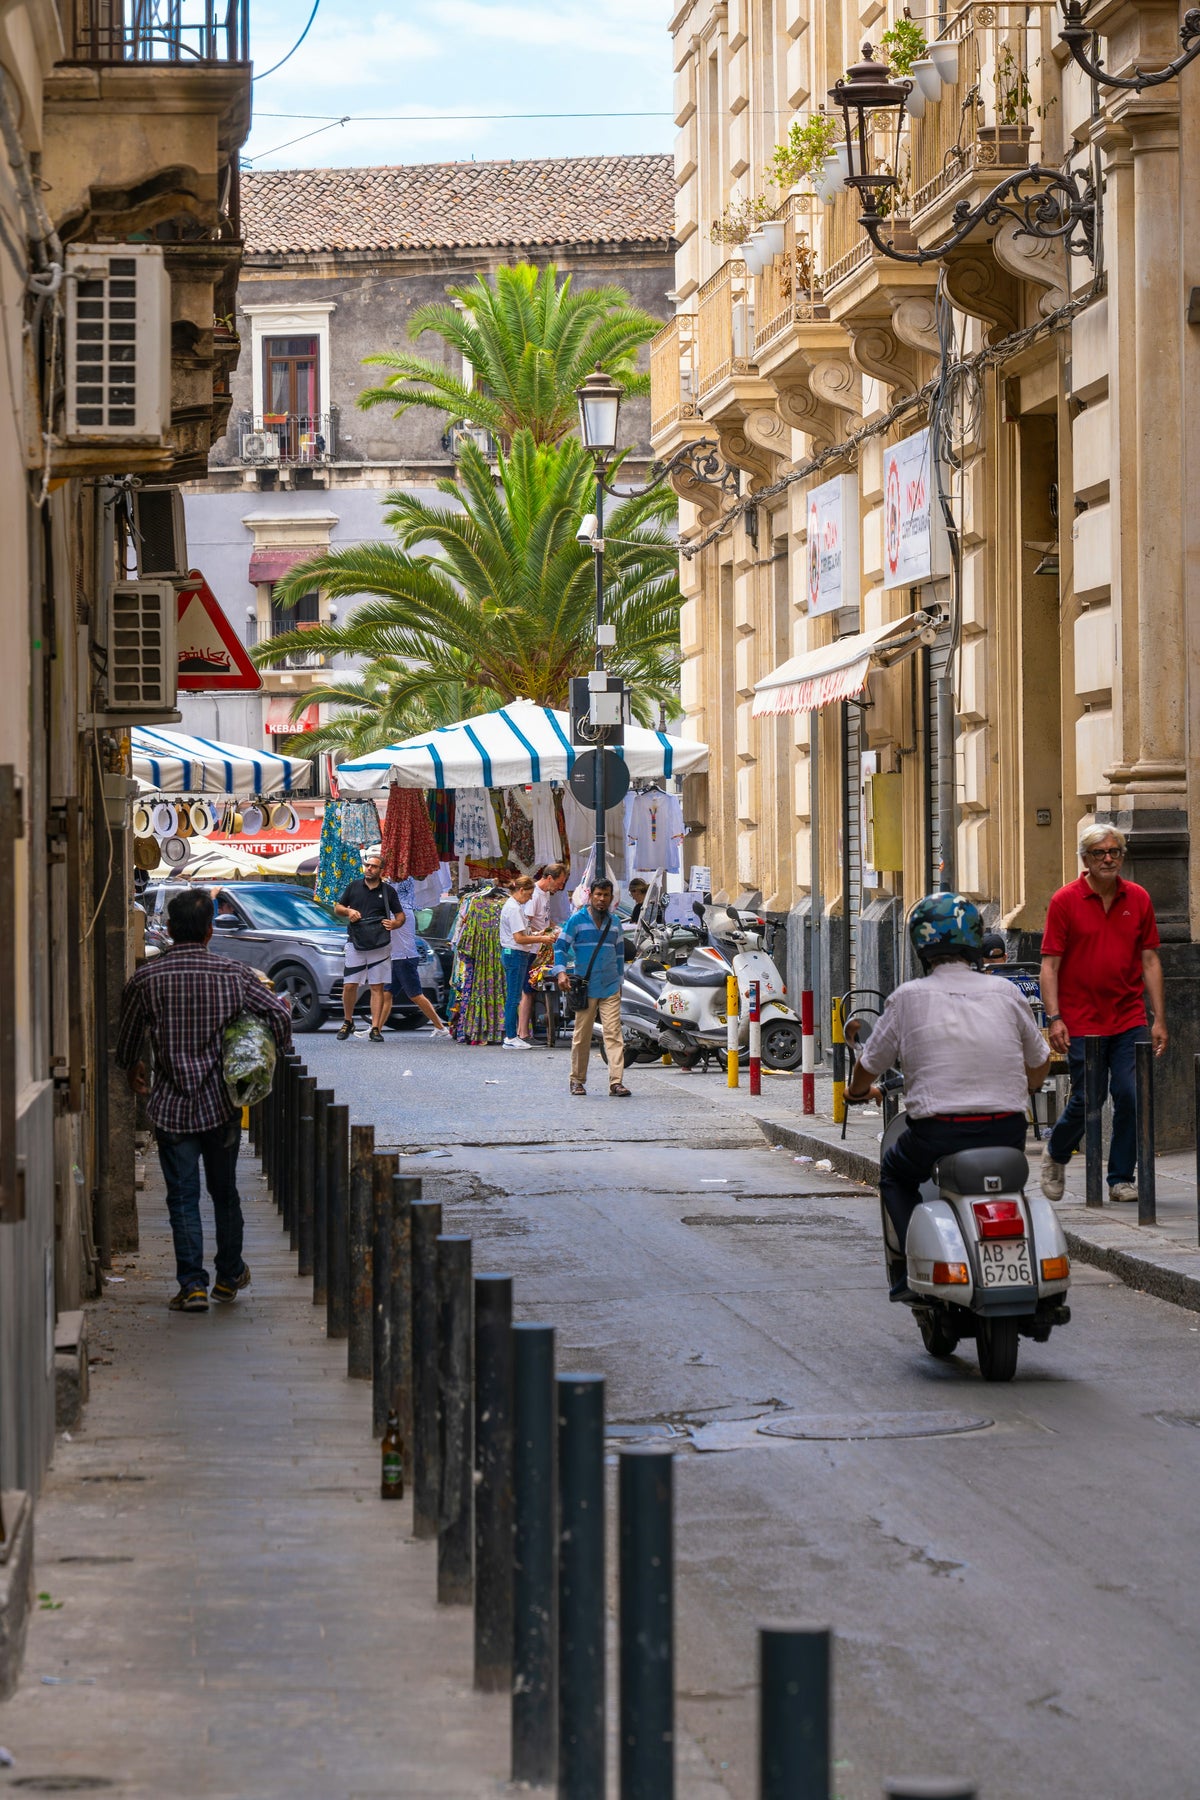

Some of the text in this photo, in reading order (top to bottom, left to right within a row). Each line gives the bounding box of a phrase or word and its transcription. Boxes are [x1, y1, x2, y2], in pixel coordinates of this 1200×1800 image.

[269, 724, 304, 733] KEBAB
[983, 1243, 1028, 1263] AB 2
[985, 1263, 1030, 1283] 6706
